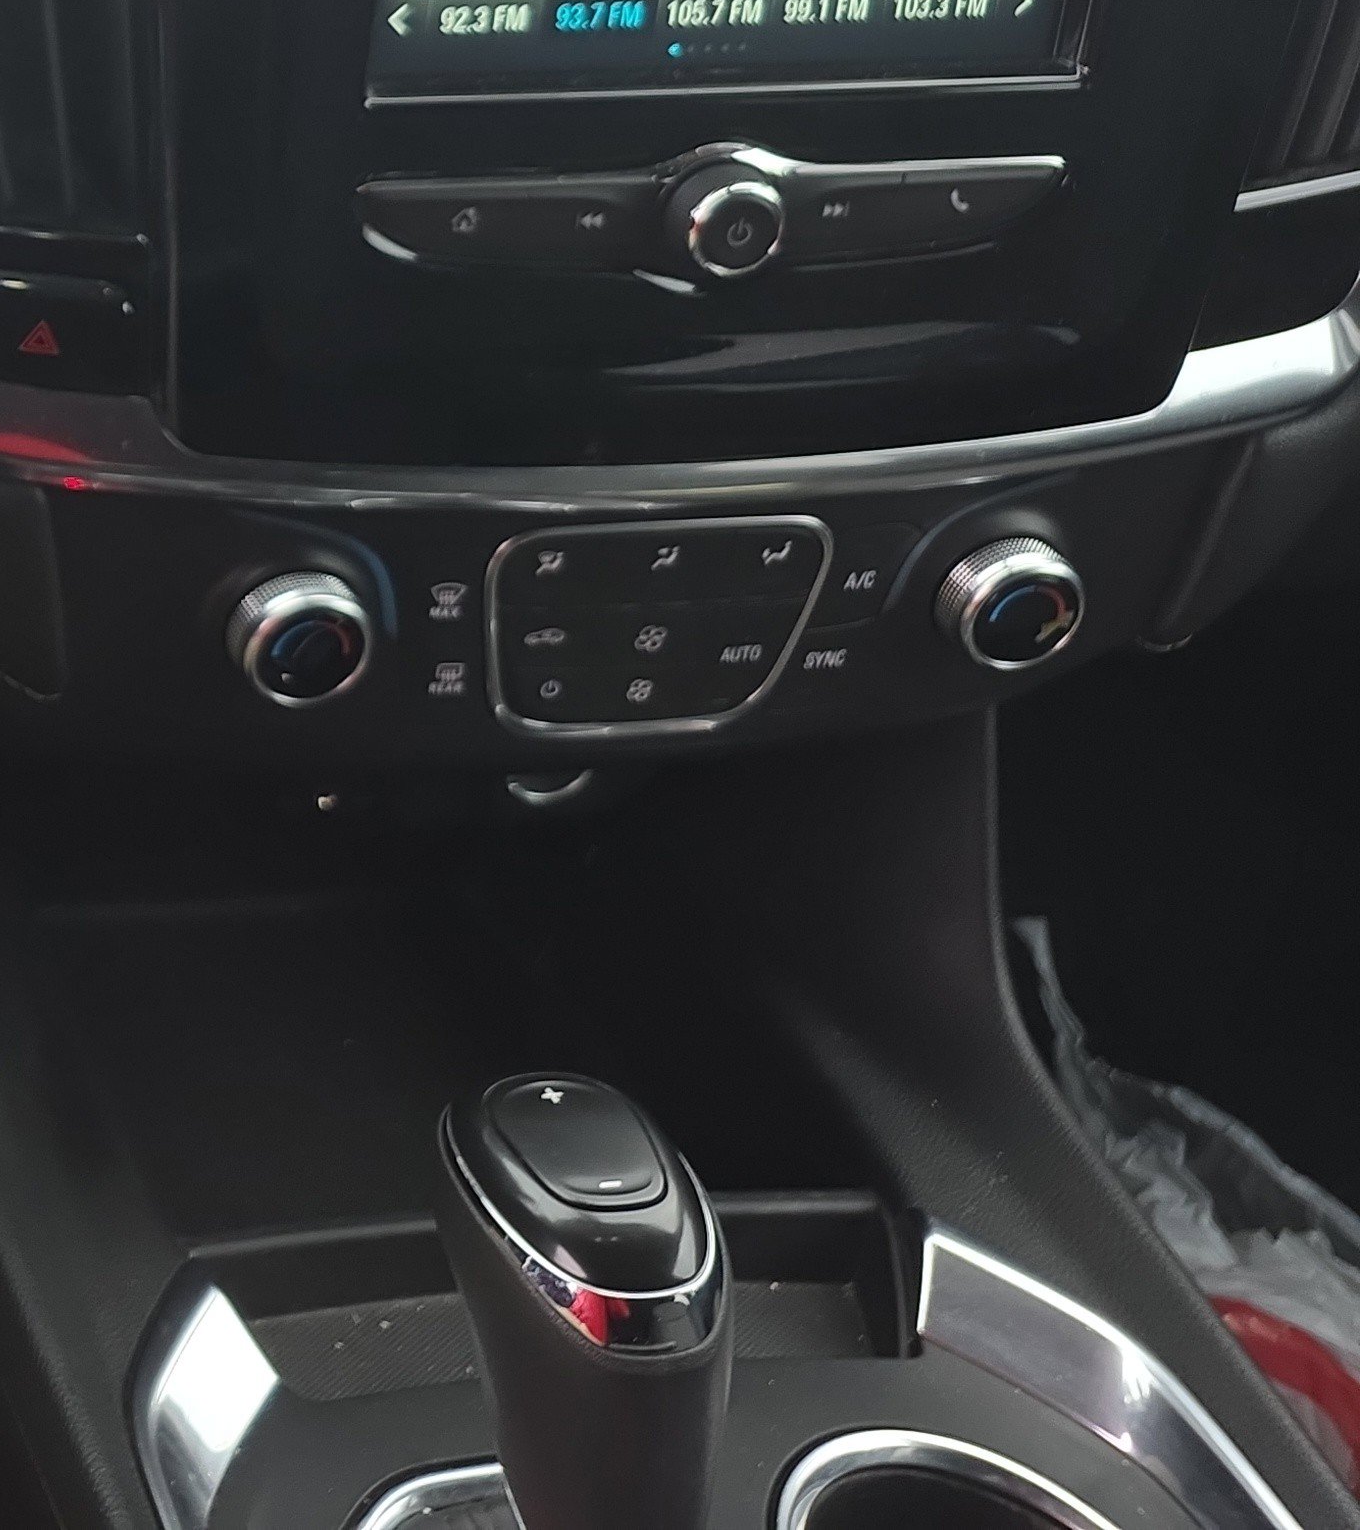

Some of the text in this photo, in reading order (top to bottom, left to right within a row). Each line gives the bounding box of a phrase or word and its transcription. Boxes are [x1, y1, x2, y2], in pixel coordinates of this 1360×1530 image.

[440, 3, 530, 35] 92.3 FM
[555, 0, 646, 31] 93.7 FM
[843, 571, 878, 591] A/C
[719, 644, 763, 663] AUTO
[803, 649, 848, 670] SYNC
